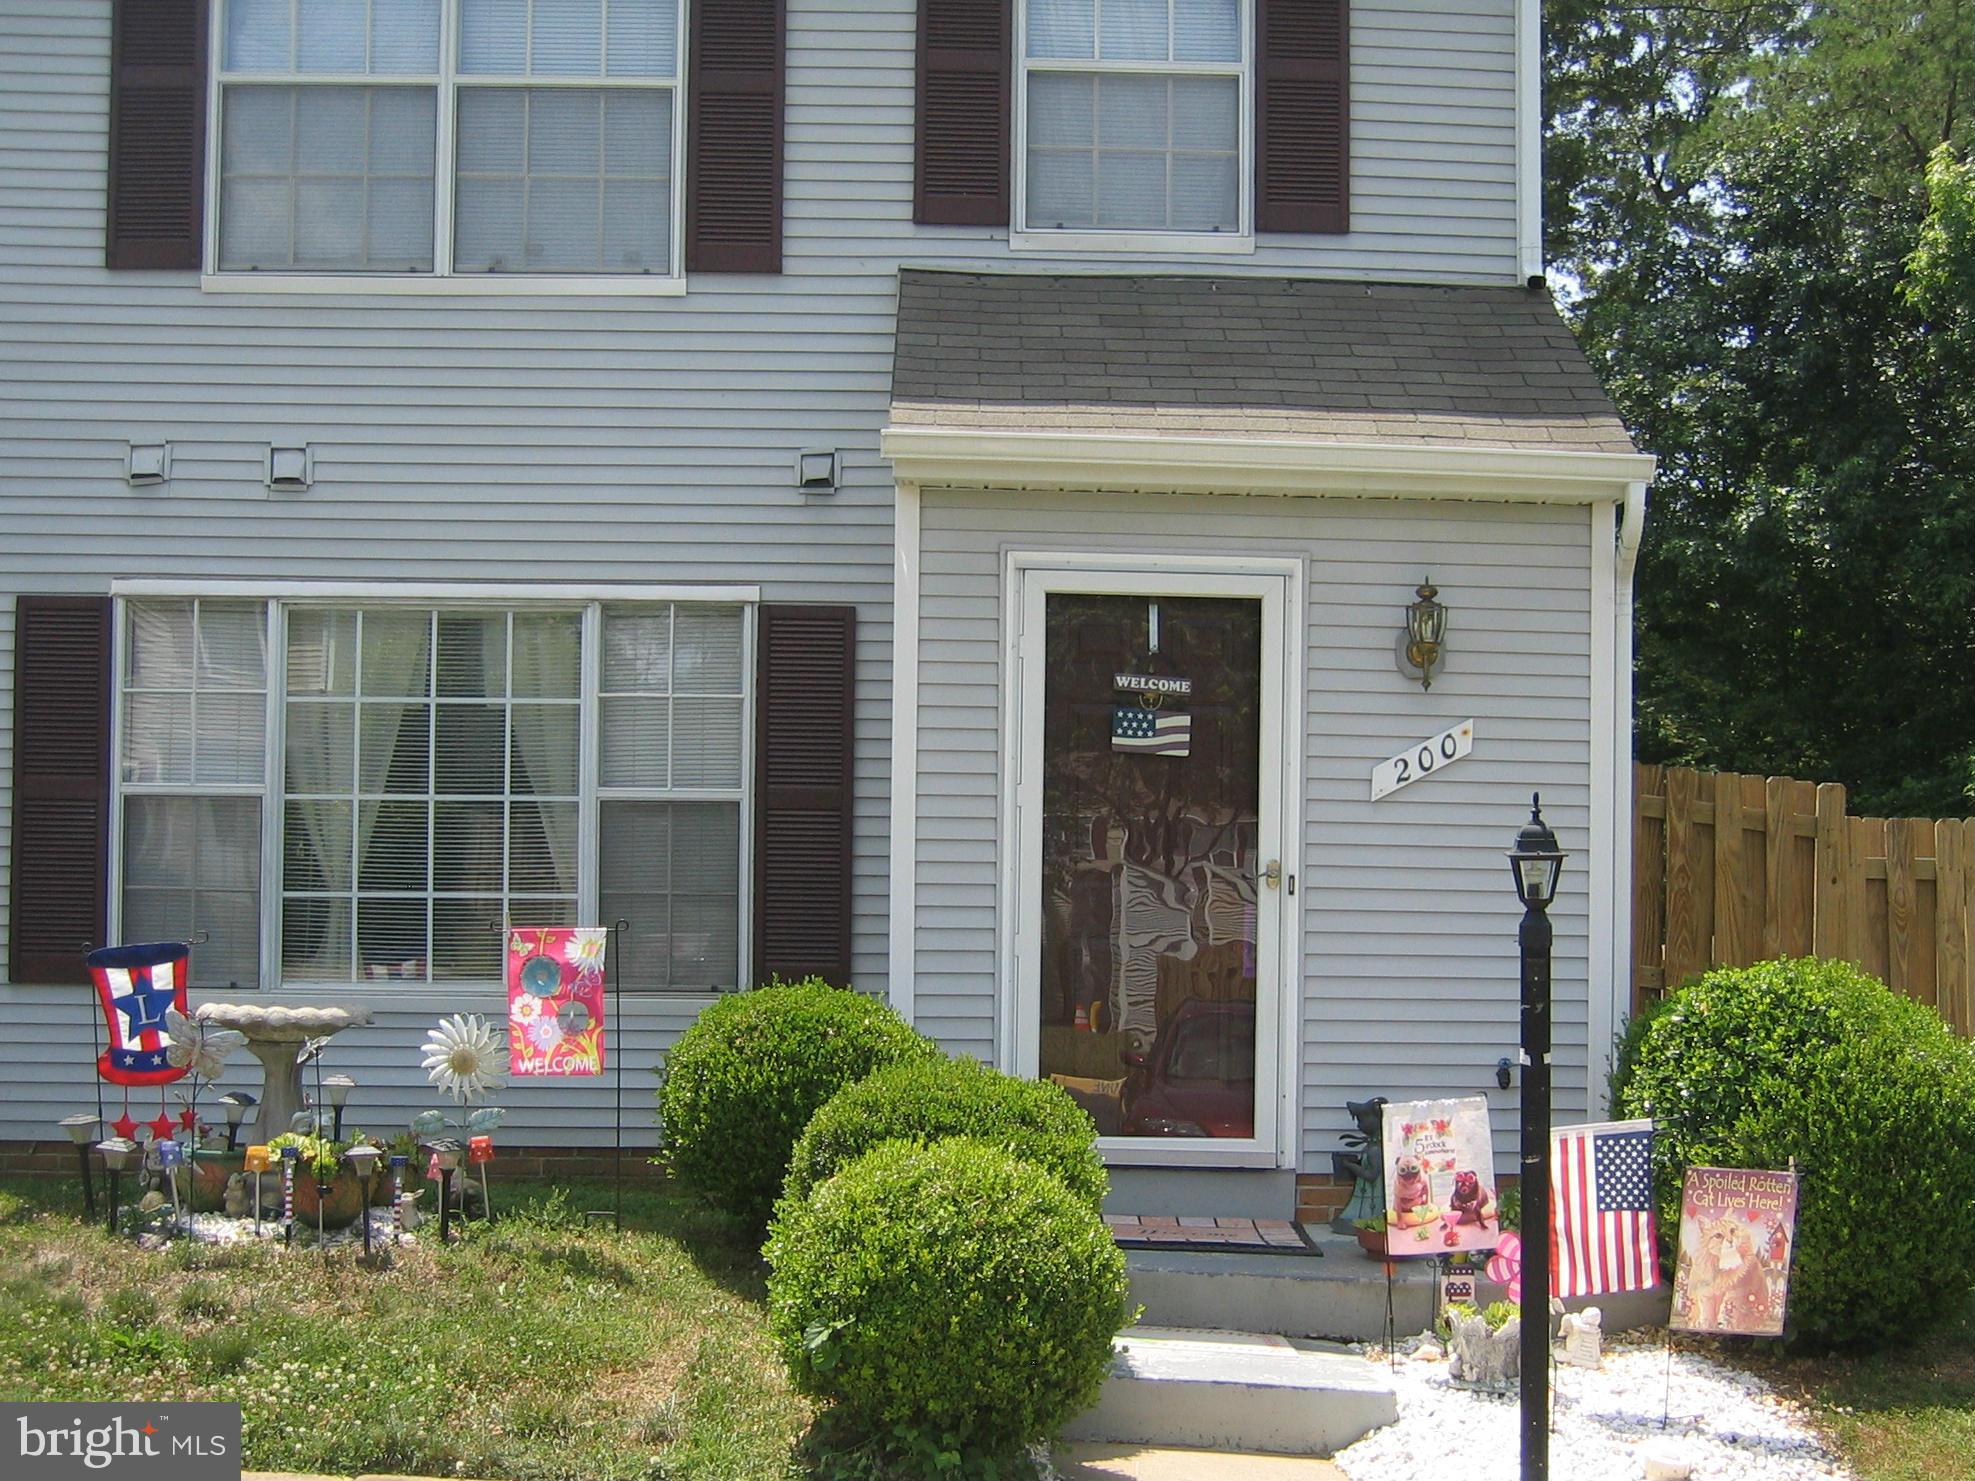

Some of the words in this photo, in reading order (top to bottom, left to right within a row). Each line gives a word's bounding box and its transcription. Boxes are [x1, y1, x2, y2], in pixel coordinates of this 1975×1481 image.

[1115, 676, 1192, 693] WELCOME
[1394, 733, 1457, 785] 200
[134, 994, 161, 1025] L
[518, 1056, 598, 1074] WELCOME
[1415, 1138, 1425, 1154] 5
[1687, 1172, 1699, 1187] A
[1703, 1172, 1745, 1193] Spoiled
[1749, 1177, 1792, 1195] Rotten
[1693, 1190, 1714, 1207] Cat
[1718, 1191, 1745, 1207] Lives
[1749, 1193, 1783, 1210] Here!
